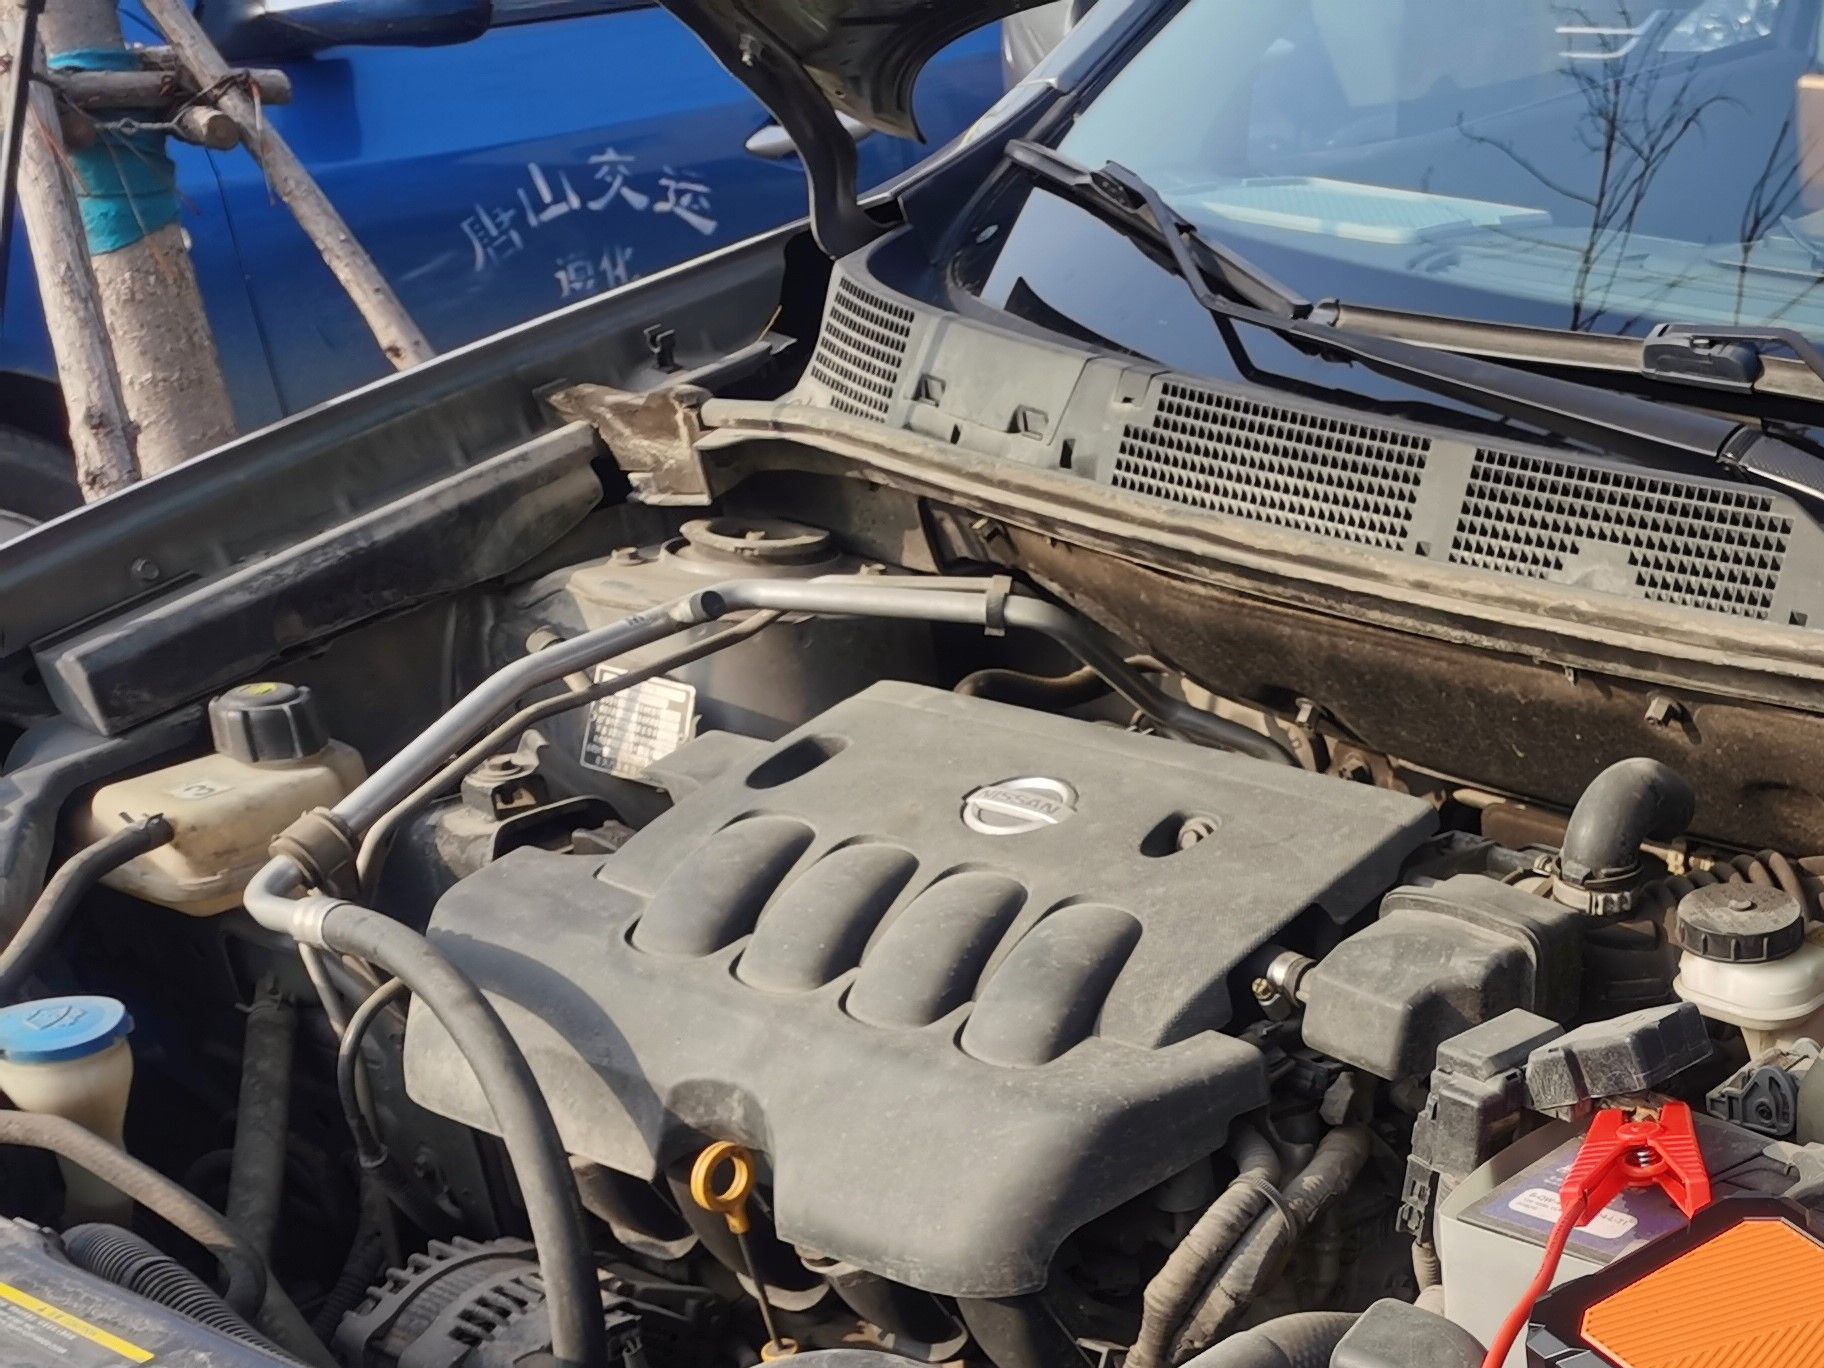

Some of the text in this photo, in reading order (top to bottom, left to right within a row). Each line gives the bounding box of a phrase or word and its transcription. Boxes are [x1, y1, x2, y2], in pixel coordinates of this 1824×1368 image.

[459, 147, 718, 272] 唐山交运
[981, 787, 1062, 815] NISSAN
